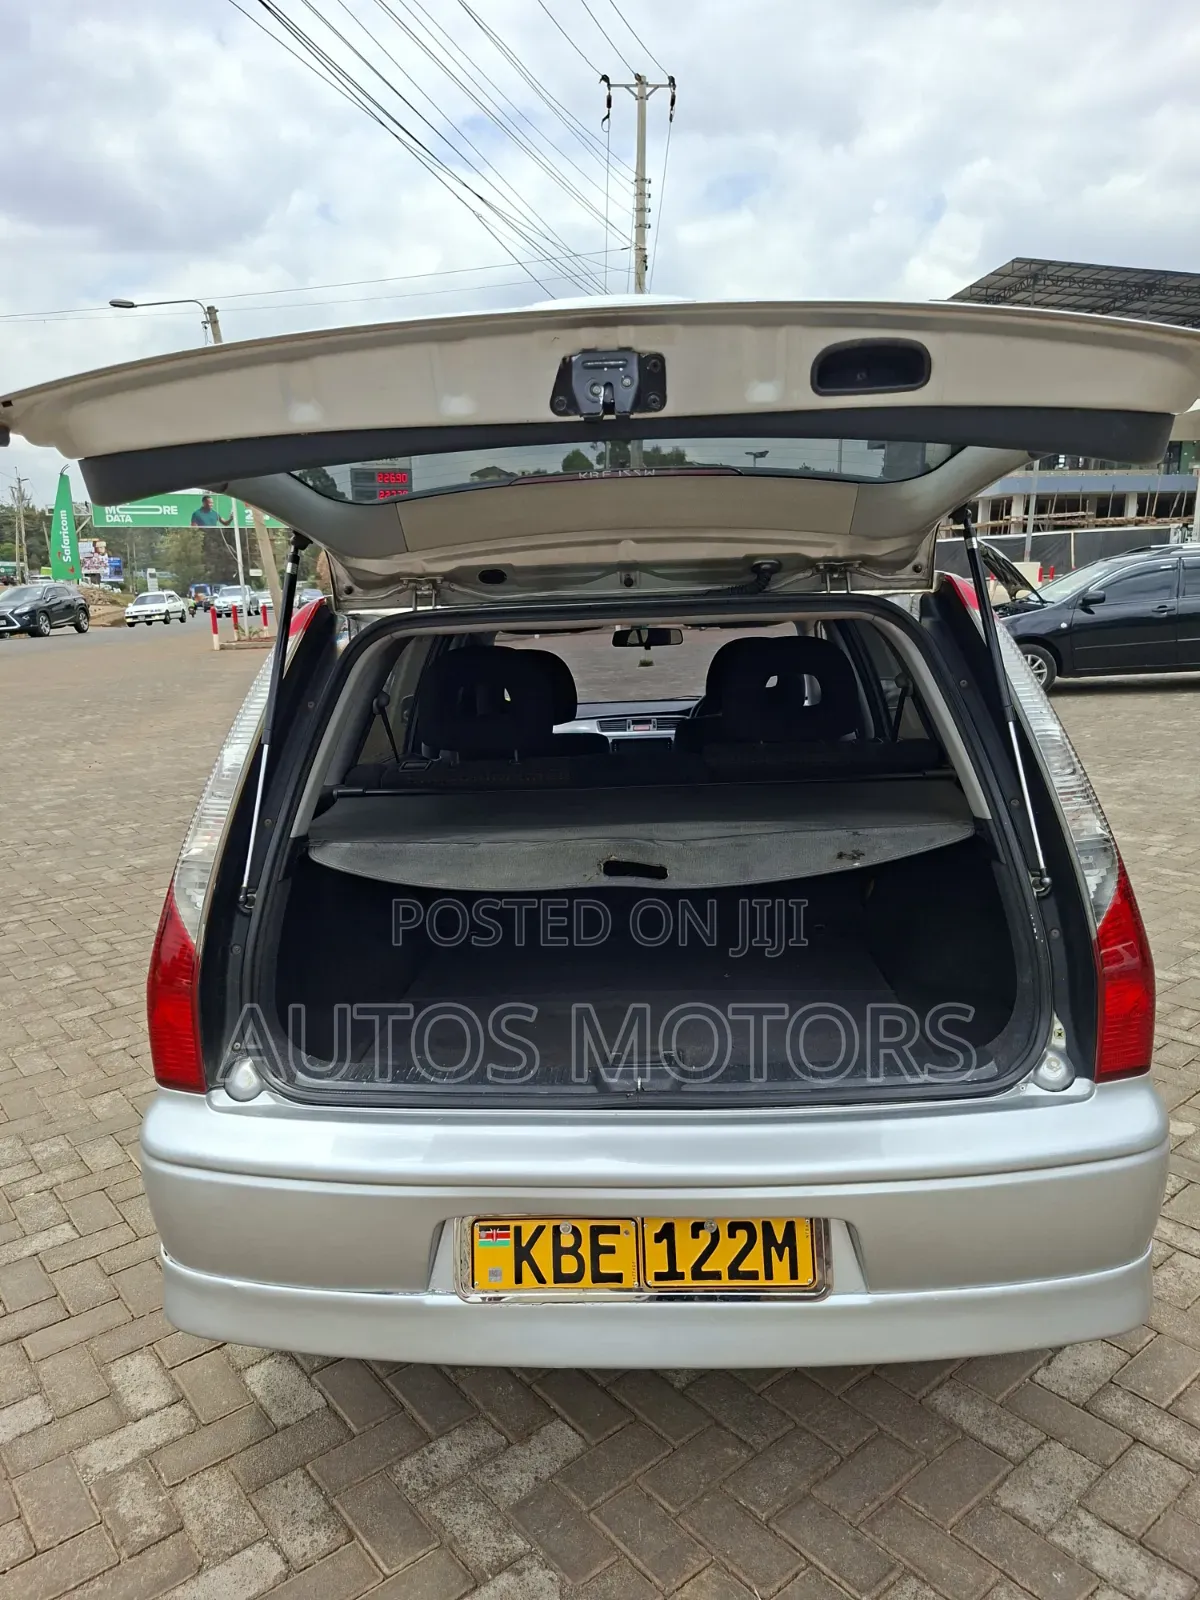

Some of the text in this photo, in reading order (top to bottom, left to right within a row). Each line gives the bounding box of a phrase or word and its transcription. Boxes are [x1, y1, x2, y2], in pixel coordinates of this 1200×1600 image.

[60, 510, 72, 562] Safaricom
[106, 514, 133, 523] DATA
[513, 1224, 624, 1285] KBE
[653, 1217, 799, 1283] 122M
